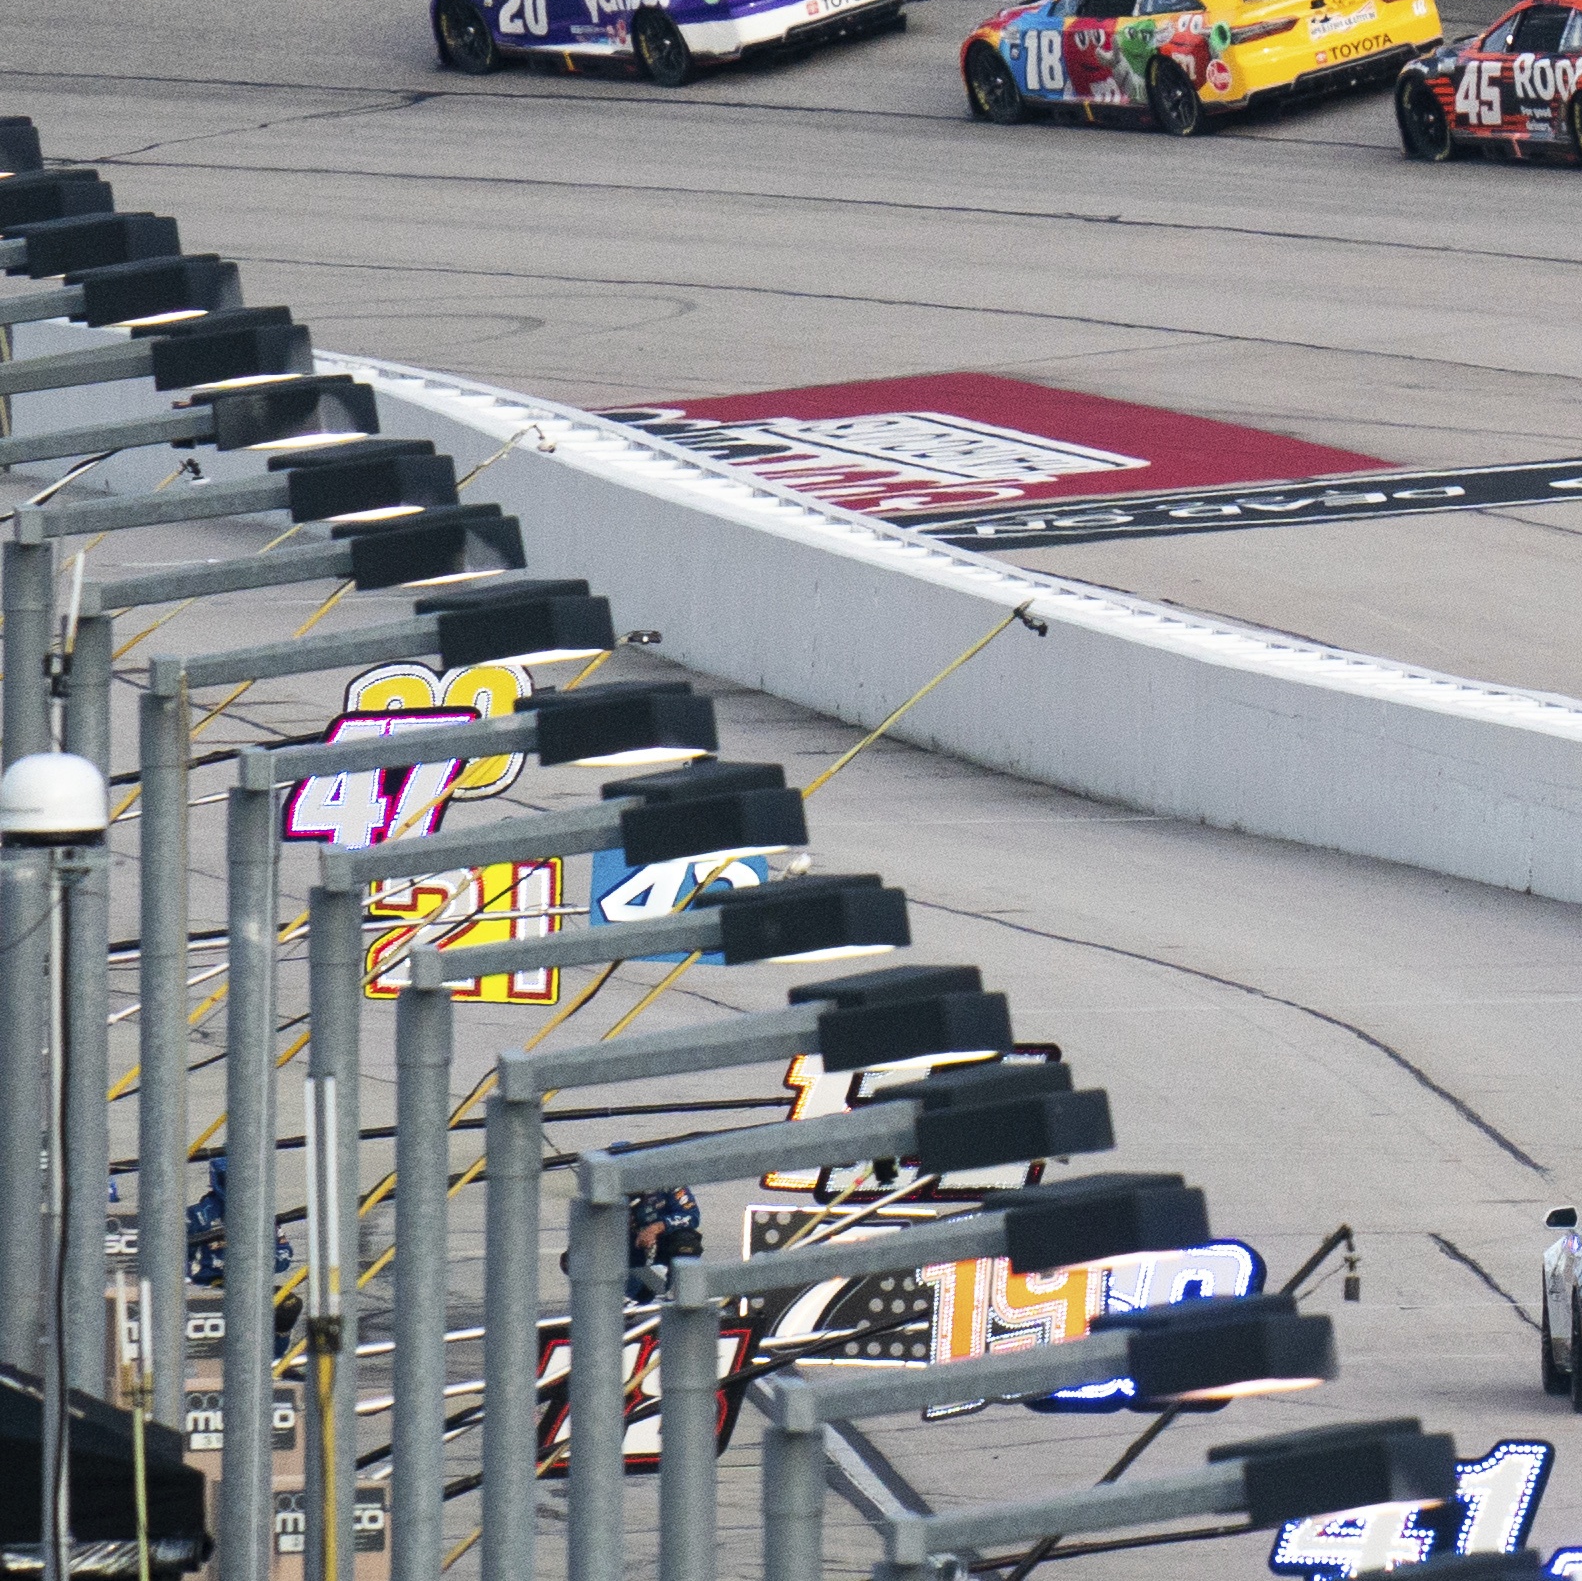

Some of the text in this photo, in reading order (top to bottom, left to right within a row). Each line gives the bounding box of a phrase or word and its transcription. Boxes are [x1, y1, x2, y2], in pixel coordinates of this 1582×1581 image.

[1024, 29, 1066, 92] 18
[1328, 32, 1394, 61] TOYOTA
[1455, 61, 1502, 126] 45
